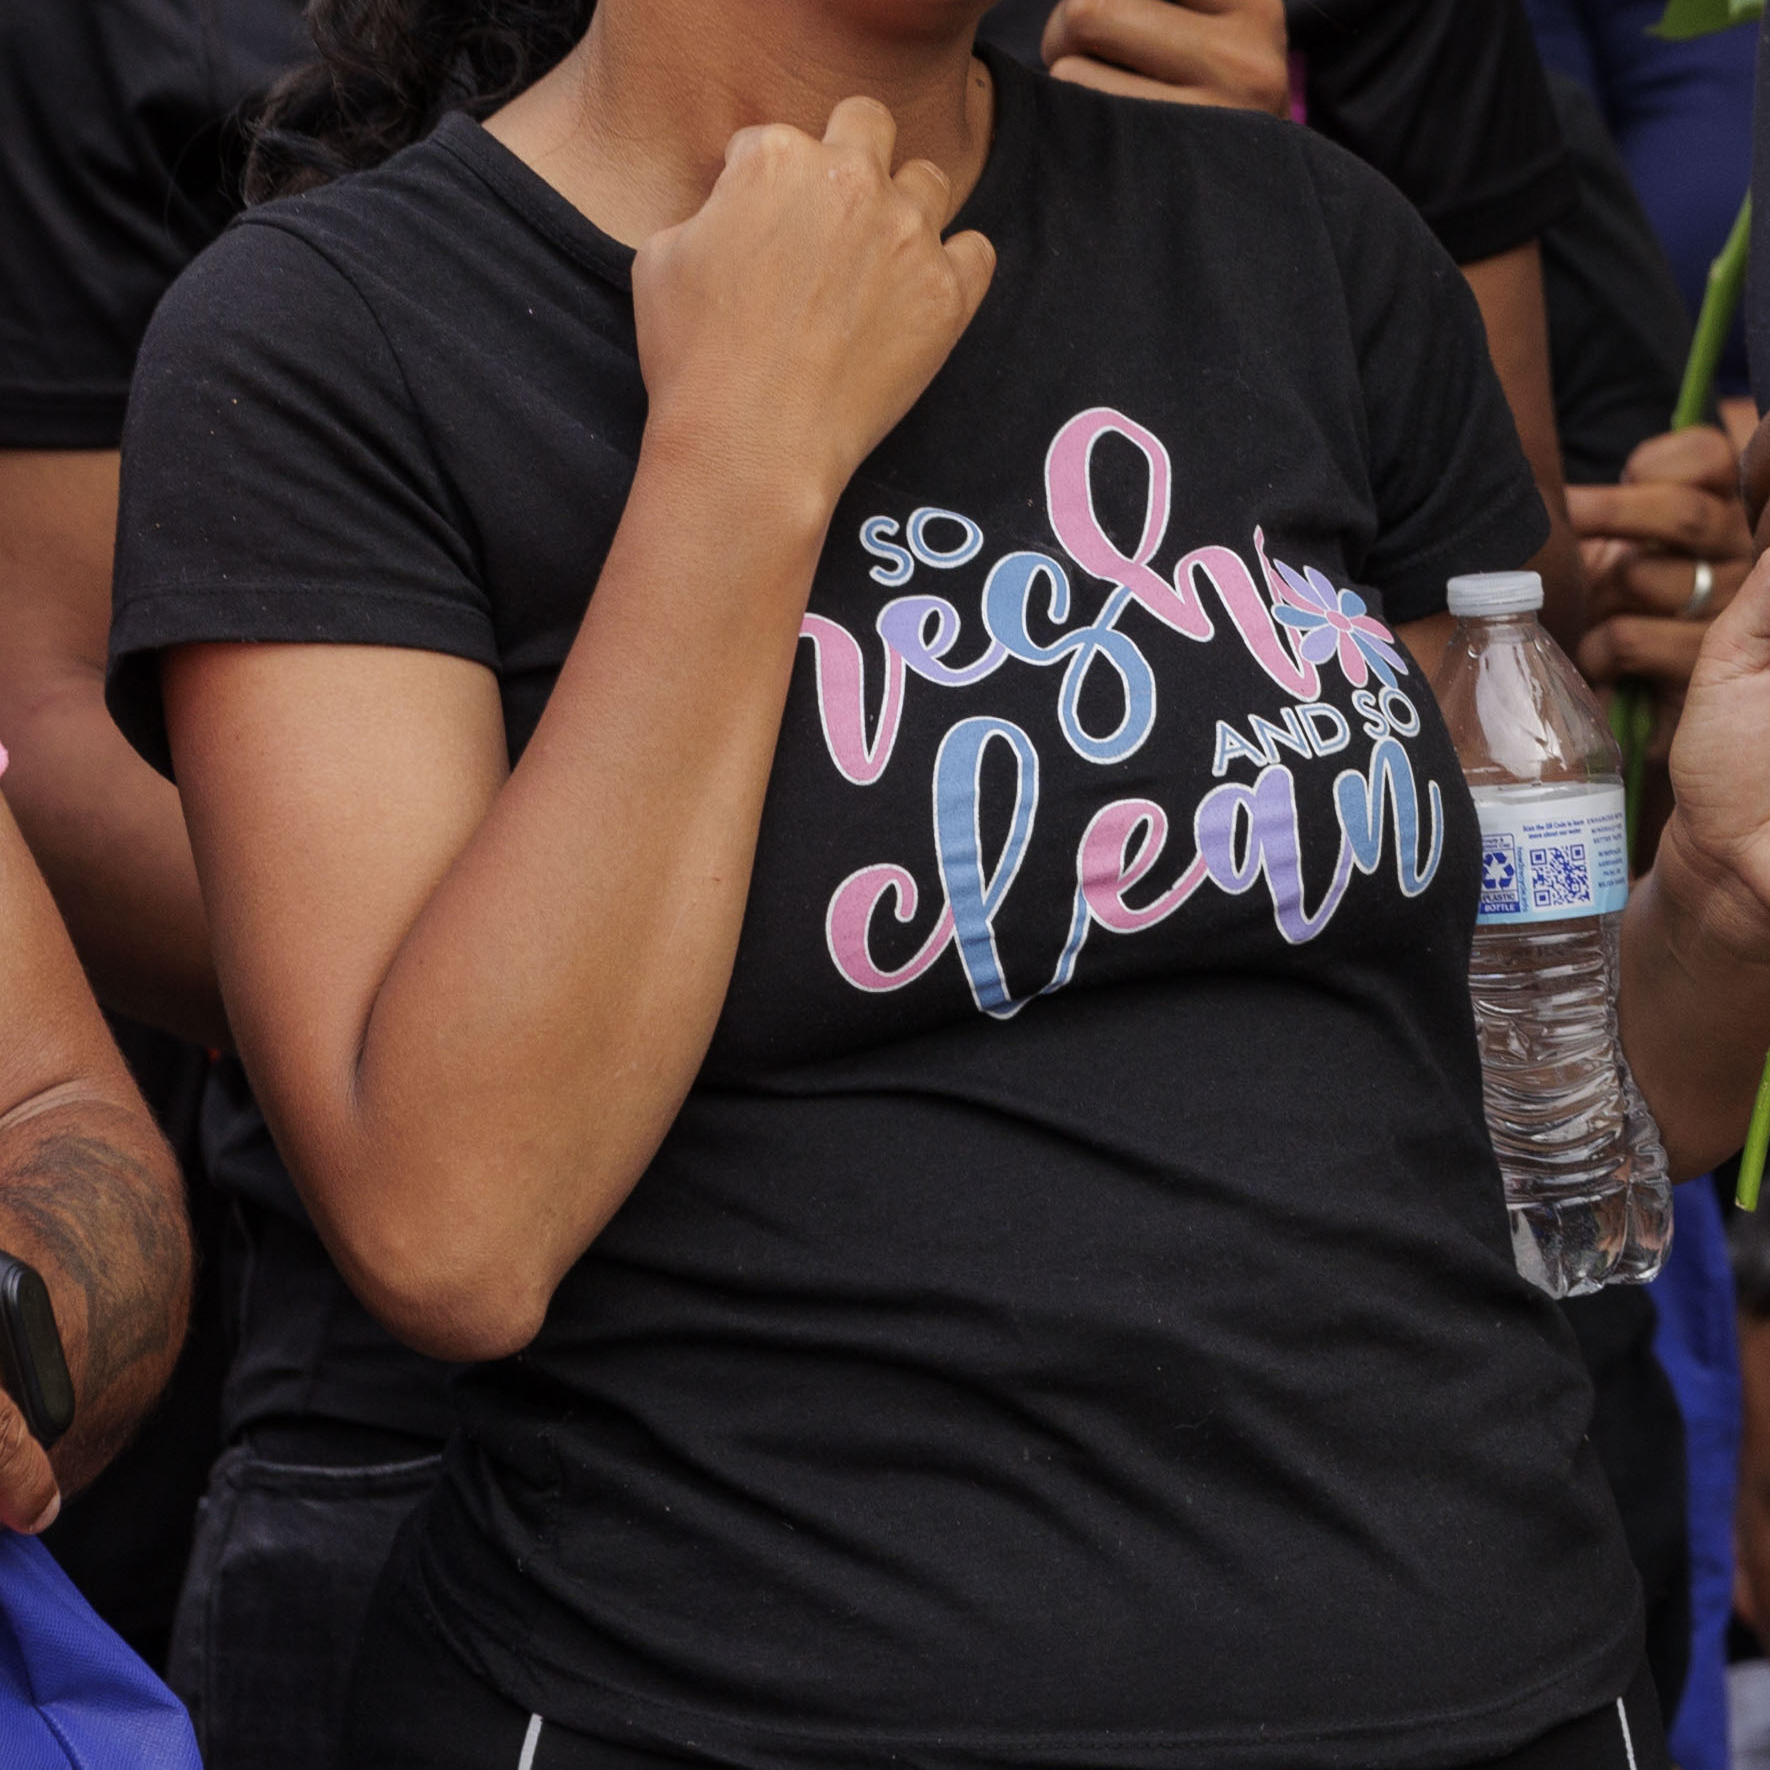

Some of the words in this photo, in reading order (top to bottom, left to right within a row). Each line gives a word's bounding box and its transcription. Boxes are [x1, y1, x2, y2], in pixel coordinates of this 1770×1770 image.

[860, 507, 983, 587] SO
[799, 406, 1320, 786] resh
[1212, 703, 1350, 776] AND
[1352, 685, 1421, 738] SO
[825, 715, 1444, 1020] clean
[1482, 893, 1516, 902] PLASTIC
[1484, 903, 1515, 912] BOTTLE
